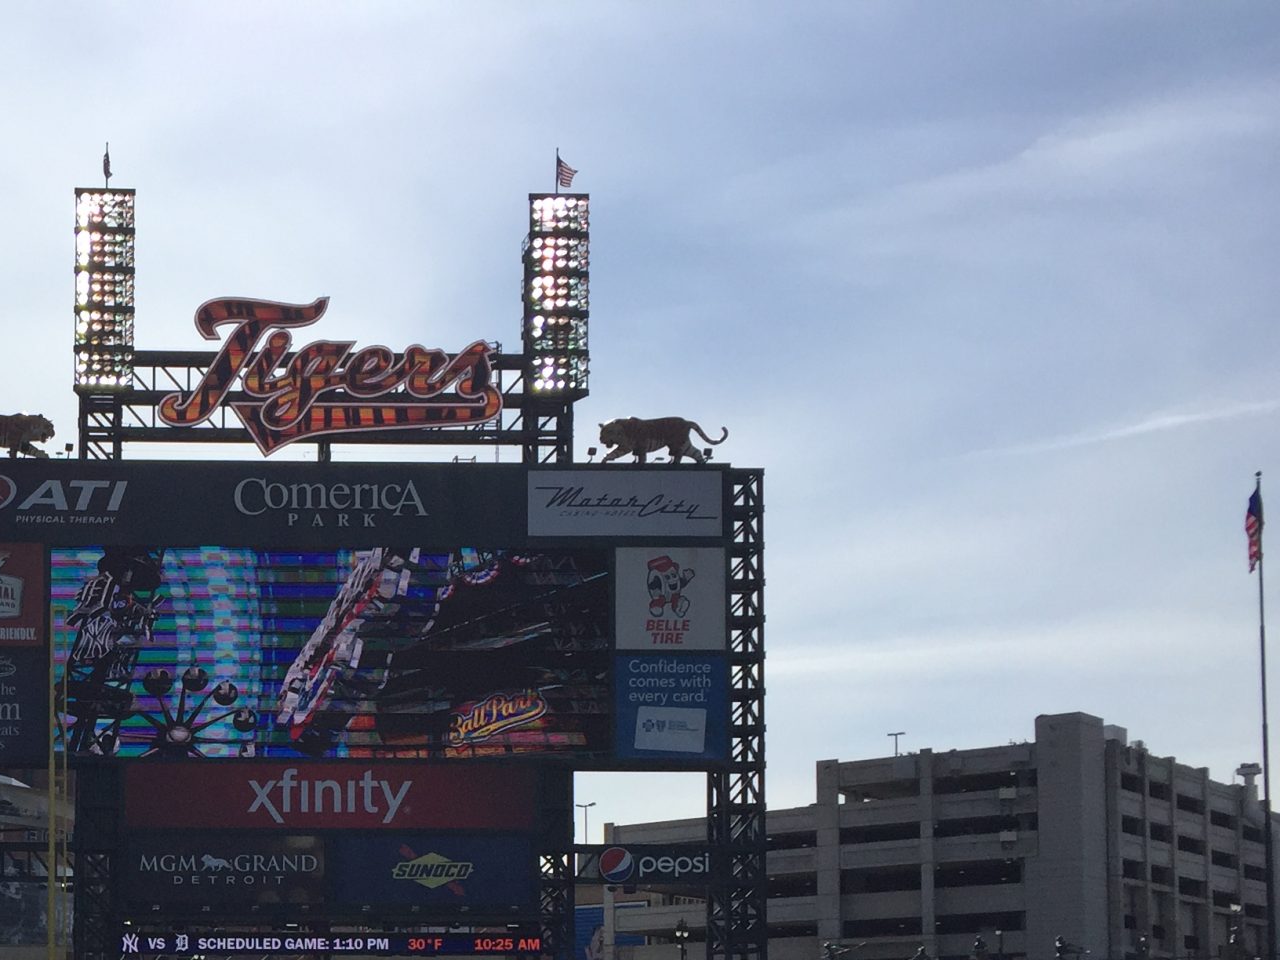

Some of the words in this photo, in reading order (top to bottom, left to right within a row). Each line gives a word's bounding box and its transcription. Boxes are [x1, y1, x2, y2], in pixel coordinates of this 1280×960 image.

[158, 296, 503, 458] Tigers
[17, 479, 128, 511] ATI
[16, 515, 66, 524] PHYSICAL
[70, 516, 116, 525] THERAPY
[288, 513, 376, 527] PARK
[645, 619, 690, 632] BELLE
[651, 632, 684, 645] TIRE
[628, 659, 711, 673] Confidence
[628, 677, 676, 688] comes
[680, 674, 711, 688] with
[628, 691, 669, 706] every
[247, 768, 413, 824] xfinity
[139, 854, 199, 873] MGM
[231, 854, 318, 873] GRAND
[393, 862, 472, 879] SUNOCO
[639, 853, 710, 877] pepsi
[173, 875, 285, 885] DETROIT
[148, 937, 166, 950] VS
[198, 937, 281, 950] SCHEDULED
[285, 937, 329, 950] GAME:
[333, 938, 364, 950] 1:10
[367, 938, 389, 950] PM
[474, 938, 513, 950] 10:25
[518, 938, 540, 950] AM
